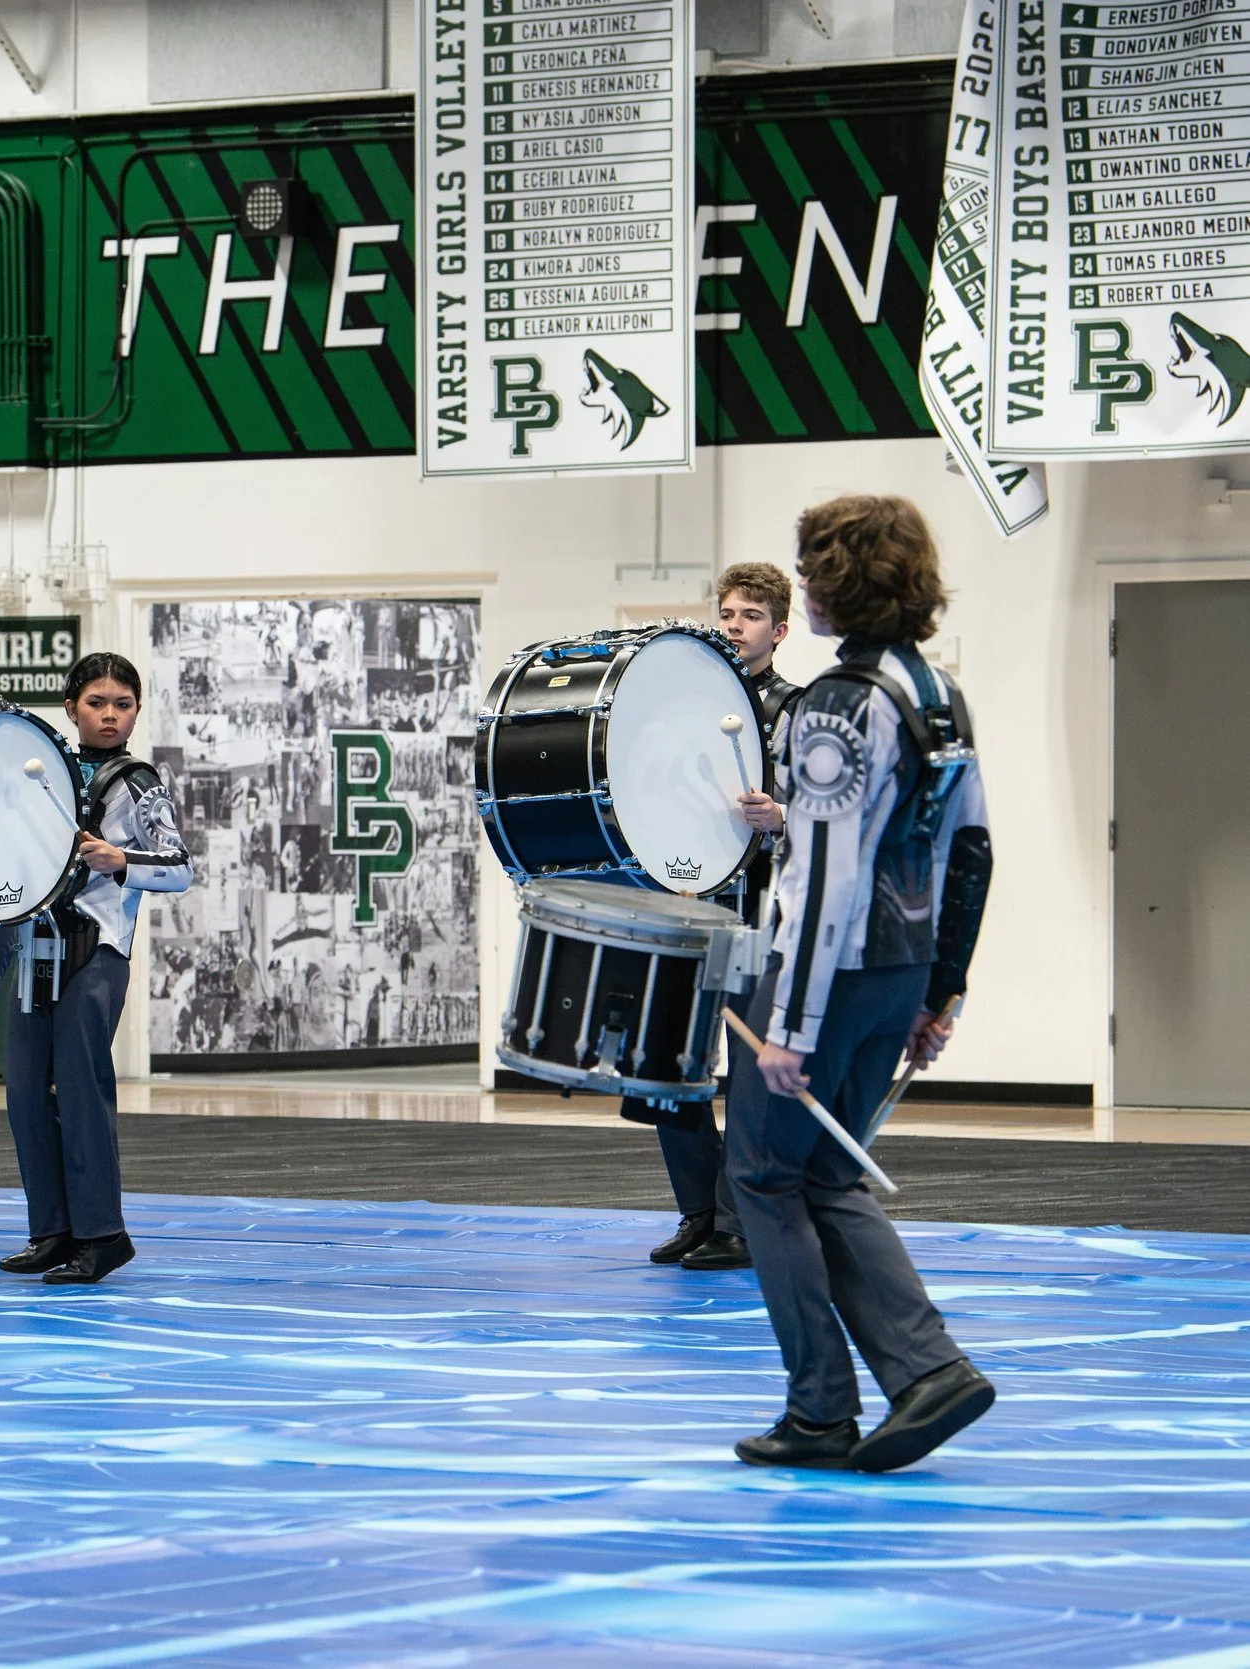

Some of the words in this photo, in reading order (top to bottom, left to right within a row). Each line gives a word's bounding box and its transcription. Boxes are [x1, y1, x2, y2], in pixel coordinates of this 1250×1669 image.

[1073, 9, 1084, 24] 4
[1109, 5, 1177, 25] ERNESTO
[493, 27, 502, 43] 7
[522, 23, 564, 40] CAYLA
[570, 15, 637, 36] MARTINEZ
[1070, 38, 1080, 55] 5
[1105, 35, 1177, 55] DONOVAN
[1183, 25, 1242, 48] NGUYEN
[490, 56, 505, 72] 10
[522, 51, 587, 70] VERONICA
[1015, 0, 1048, 130] BASKE
[1069, 70, 1078, 87] 11
[1101, 65, 1178, 85] SHANGJIN
[1184, 58, 1224, 77] CHEN
[492, 87, 503, 102] 11
[523, 80, 576, 99] GENESIS
[582, 74, 659, 94] HERNANDEZ
[1068, 101, 1080, 118] 12
[1098, 98, 1142, 115] ELIAS
[1149, 91, 1222, 111] SANCHEZ
[491, 116, 505, 132] 12
[580, 105, 640, 124] JOHNSON
[1070, 132, 1083, 150] 13
[1099, 127, 1159, 147] NATHAN
[1168, 123, 1223, 141] TOBON
[491, 145, 505, 161] 13
[523, 141, 559, 158] ARIEL
[565, 138, 603, 155] CASIO
[491, 175, 506, 191] 14
[523, 171, 563, 188] ECEIRI
[570, 168, 616, 185] LAVINA
[1071, 164, 1084, 181] 14
[1101, 158, 1180, 178] OWANTINO
[1012, 145, 1049, 243] BOYS
[1074, 195, 1087, 212] 15
[1102, 192, 1135, 209] LIAM
[1143, 187, 1216, 205] GALLEGO
[491, 204, 505, 221] 17
[524, 201, 555, 217] RUBY
[562, 196, 634, 214] RODRIGUEZ
[436, 171, 467, 275] GIRLS
[1074, 226, 1091, 243] 23
[1105, 220, 1195, 240] ALEJANDRO
[490, 234, 506, 250] 18
[524, 228, 582, 247] NORALYN
[588, 224, 660, 242] RODRIGUEZ
[489, 263, 509, 279] 24
[524, 259, 573, 276] KIMORA
[579, 256, 621, 273] JONES
[951, 257, 970, 279] 17
[1074, 257, 1092, 275] 24
[1106, 255, 1155, 271] TOMAS
[1164, 250, 1225, 268] FLORES
[102, 222, 402, 358] THE
[489, 293, 509, 309] 26
[524, 288, 585, 306] YESSENIA
[592, 284, 648, 302] AGUILAR
[1074, 289, 1094, 306] 25
[1108, 286, 1163, 303] ROBERT
[1172, 282, 1213, 298] OLEA
[489, 322, 509, 338] 94
[525, 317, 580, 335] ELEANOR
[587, 313, 653, 331] KAILIPONI
[1007, 258, 1047, 424] VARSITY
[437, 291, 467, 448] VARSITY
[670, 868, 697, 877] REMO
